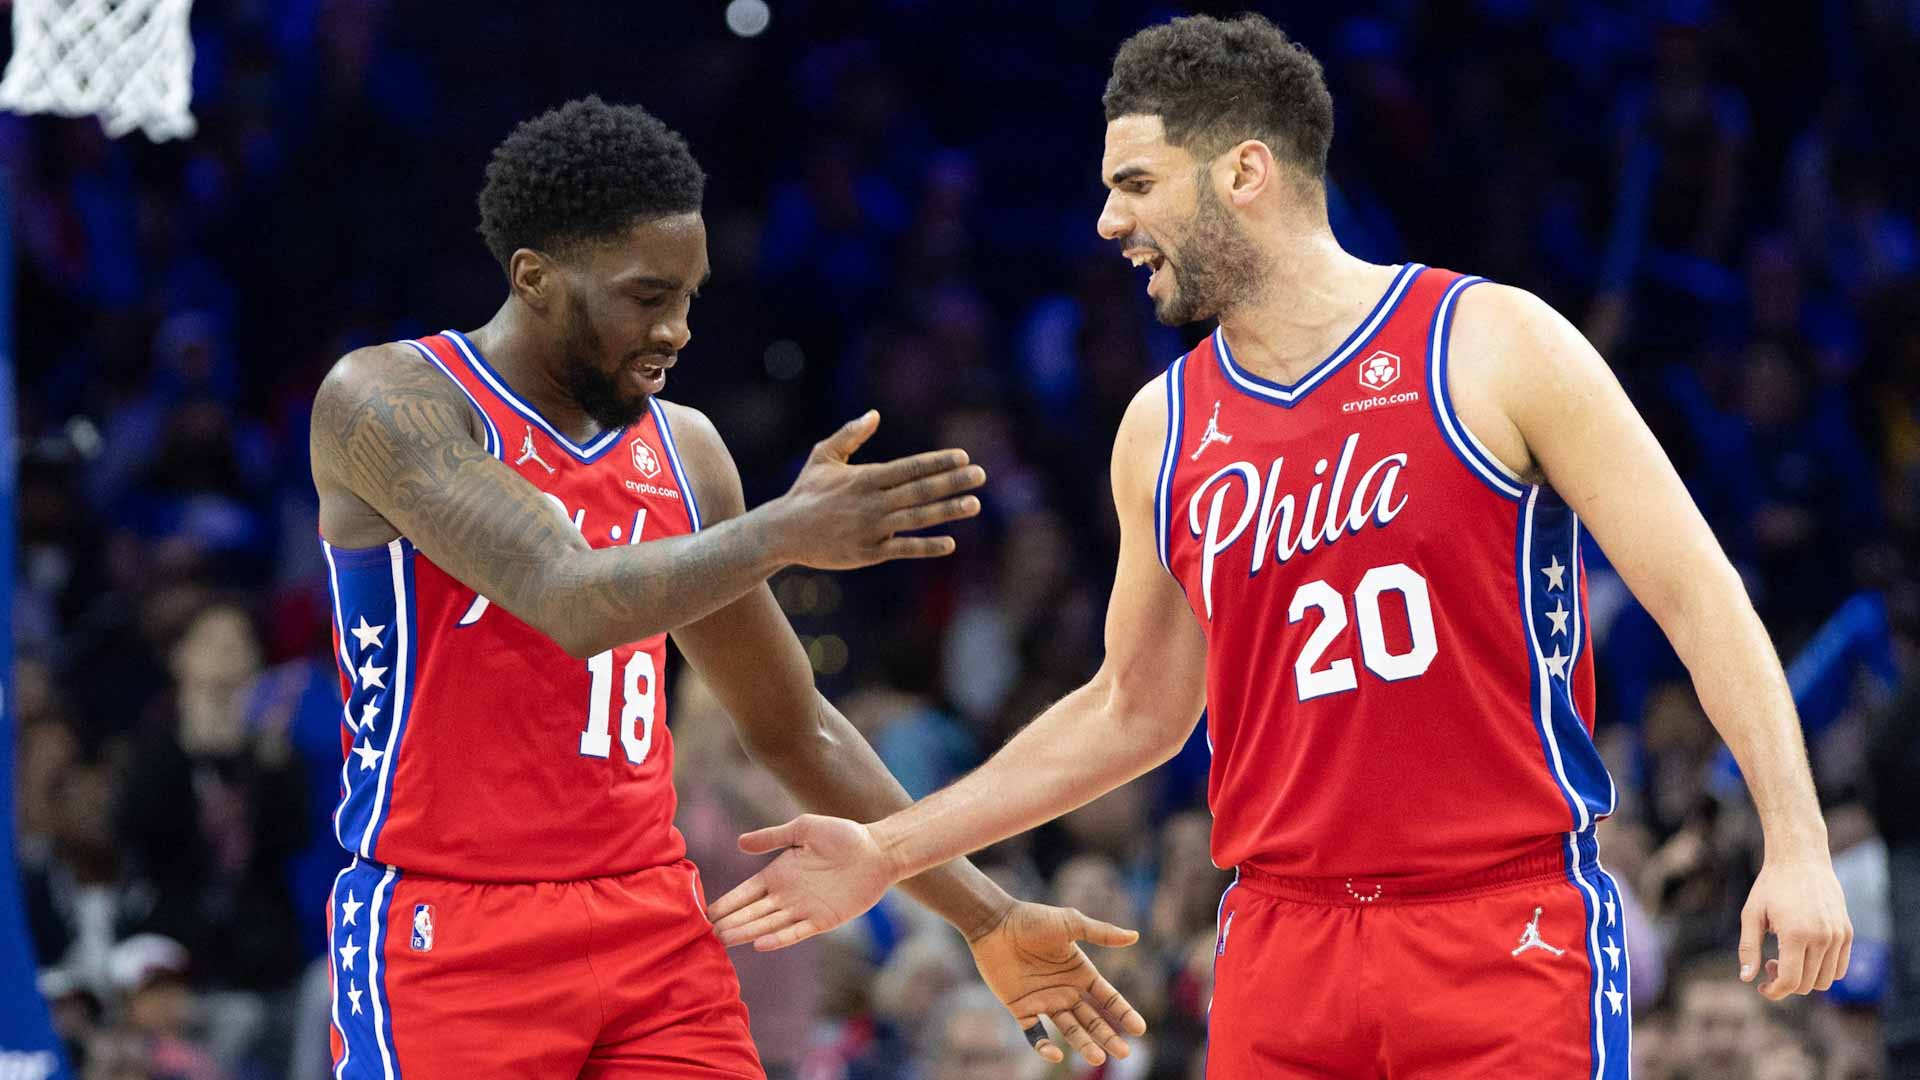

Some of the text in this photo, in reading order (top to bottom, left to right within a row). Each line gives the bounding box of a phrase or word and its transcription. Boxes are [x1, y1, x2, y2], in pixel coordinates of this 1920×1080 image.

[1342, 390, 1419, 412] crypto.com
[625, 480, 679, 499] crypto.com
[1188, 432, 1409, 622] Phila
[1288, 562, 1439, 702] 20
[578, 648, 656, 765] 18
